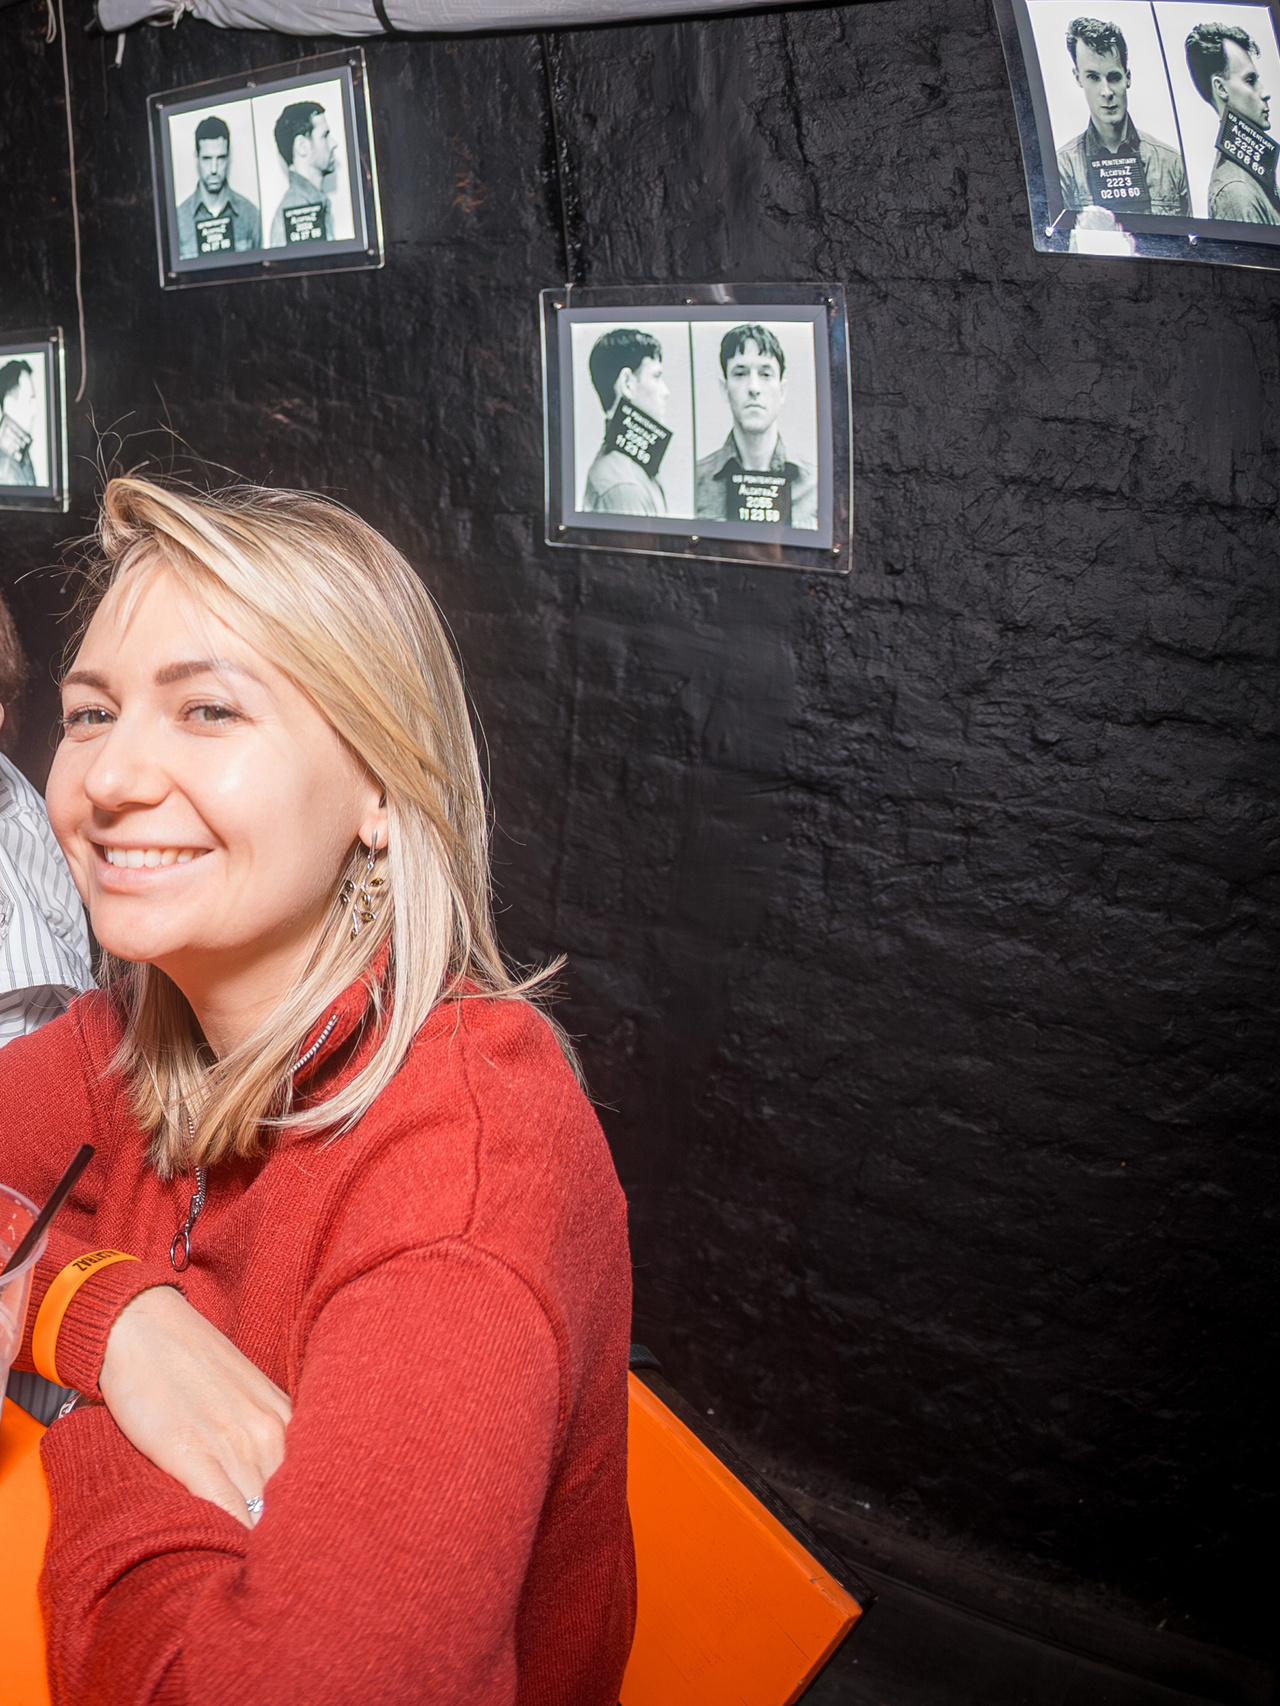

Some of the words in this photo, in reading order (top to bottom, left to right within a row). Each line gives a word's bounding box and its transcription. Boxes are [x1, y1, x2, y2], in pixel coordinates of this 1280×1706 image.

[1224, 140, 1237, 154] 02
[1237, 150, 1251, 165] 08
[1234, 137, 1261, 161] 2223
[1106, 177, 1132, 187] 2223
[1101, 189, 1113, 199] 02
